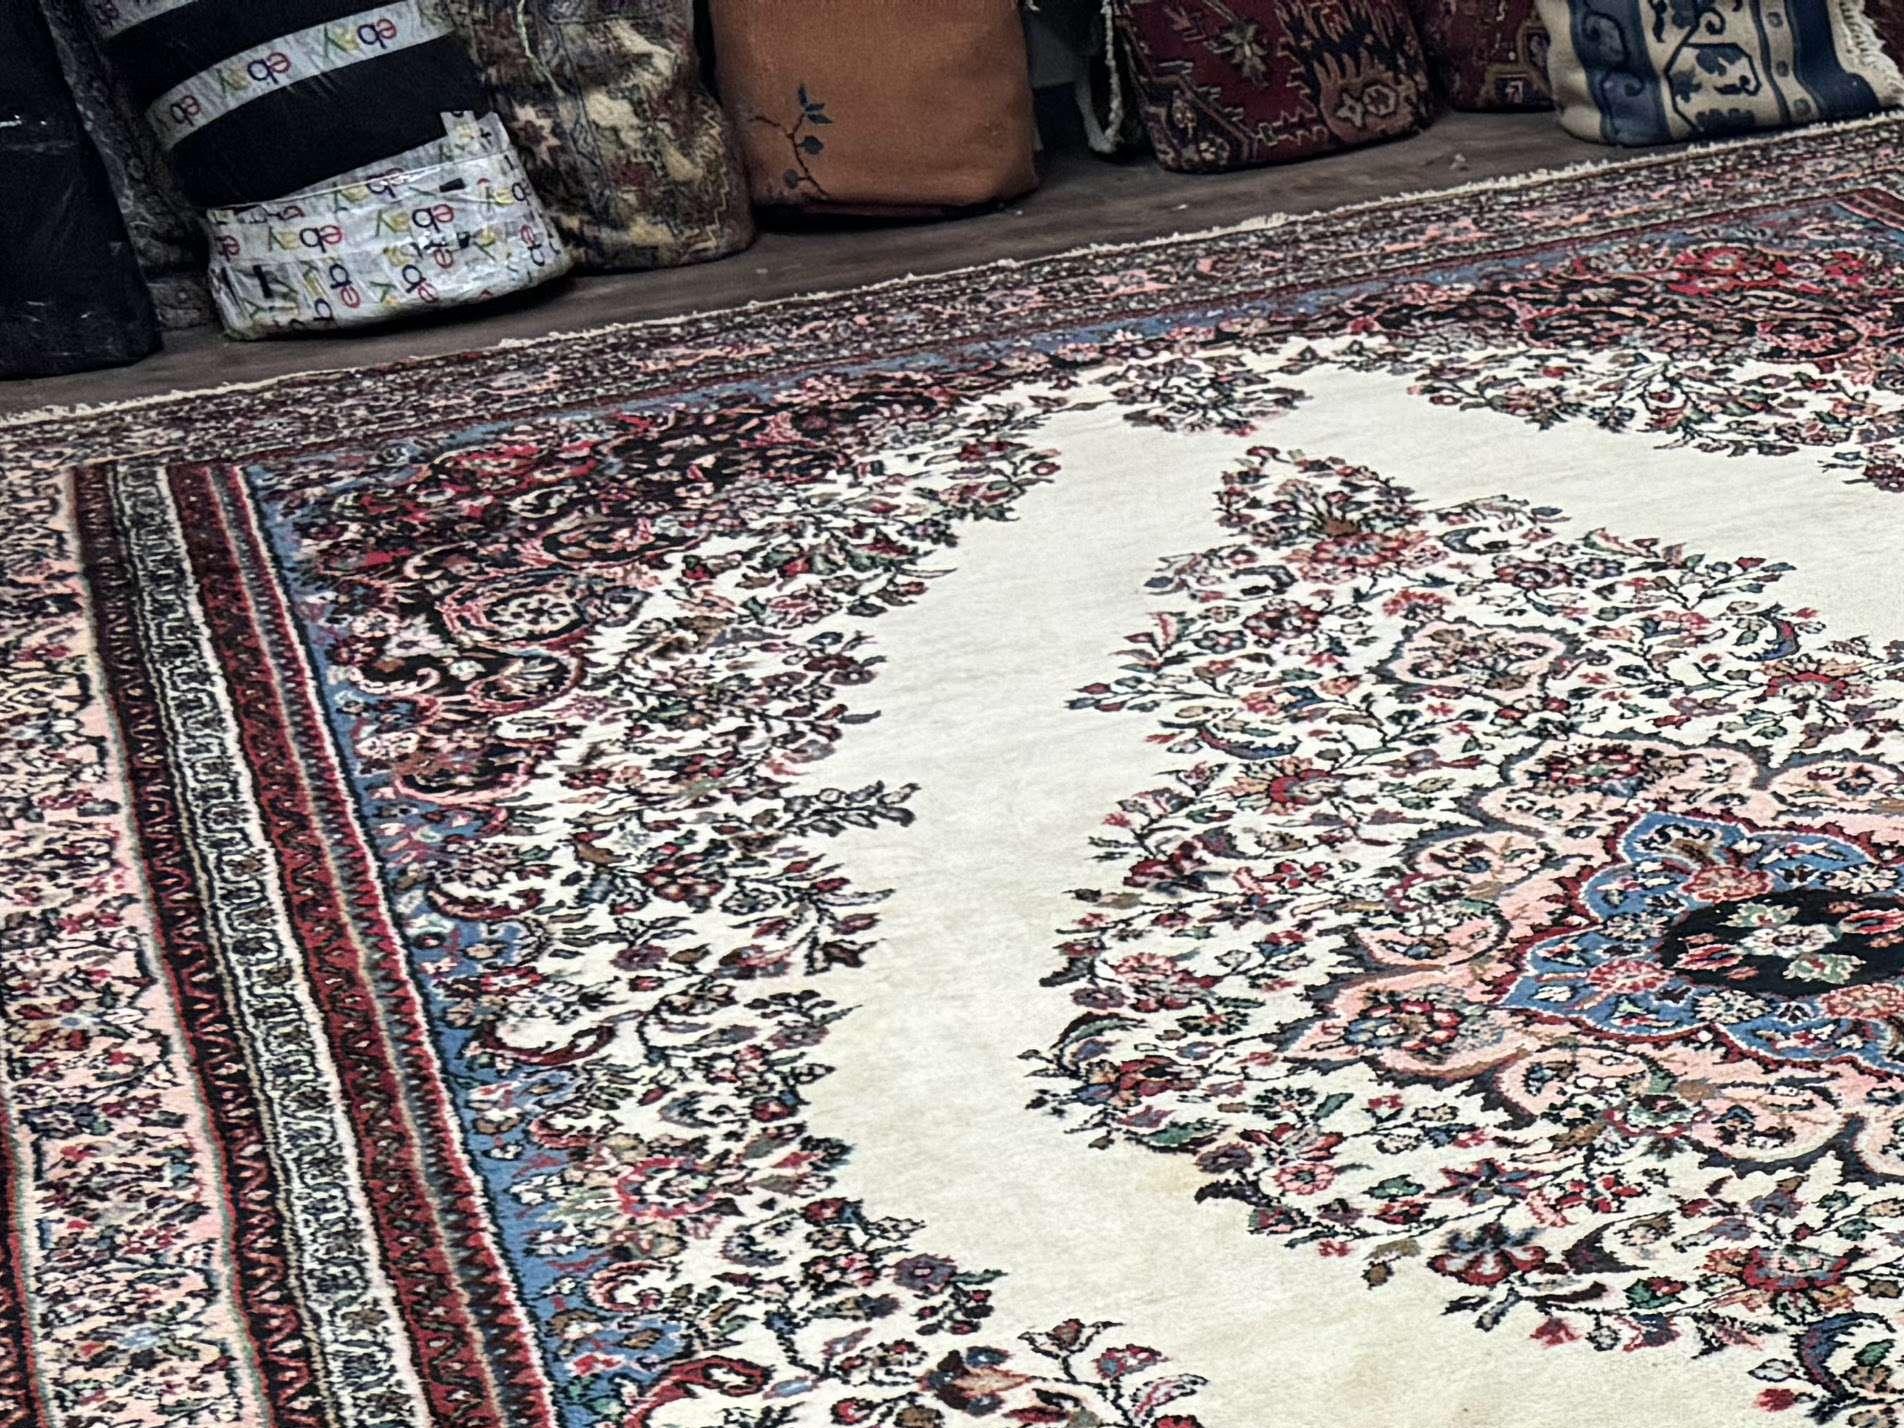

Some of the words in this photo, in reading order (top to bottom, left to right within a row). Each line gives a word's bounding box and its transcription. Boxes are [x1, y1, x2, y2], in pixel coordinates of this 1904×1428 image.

[321, 17, 398, 60] ebay
[215, 51, 292, 99] ebay
[268, 224, 343, 254] ebay
[375, 203, 455, 238] ebay
